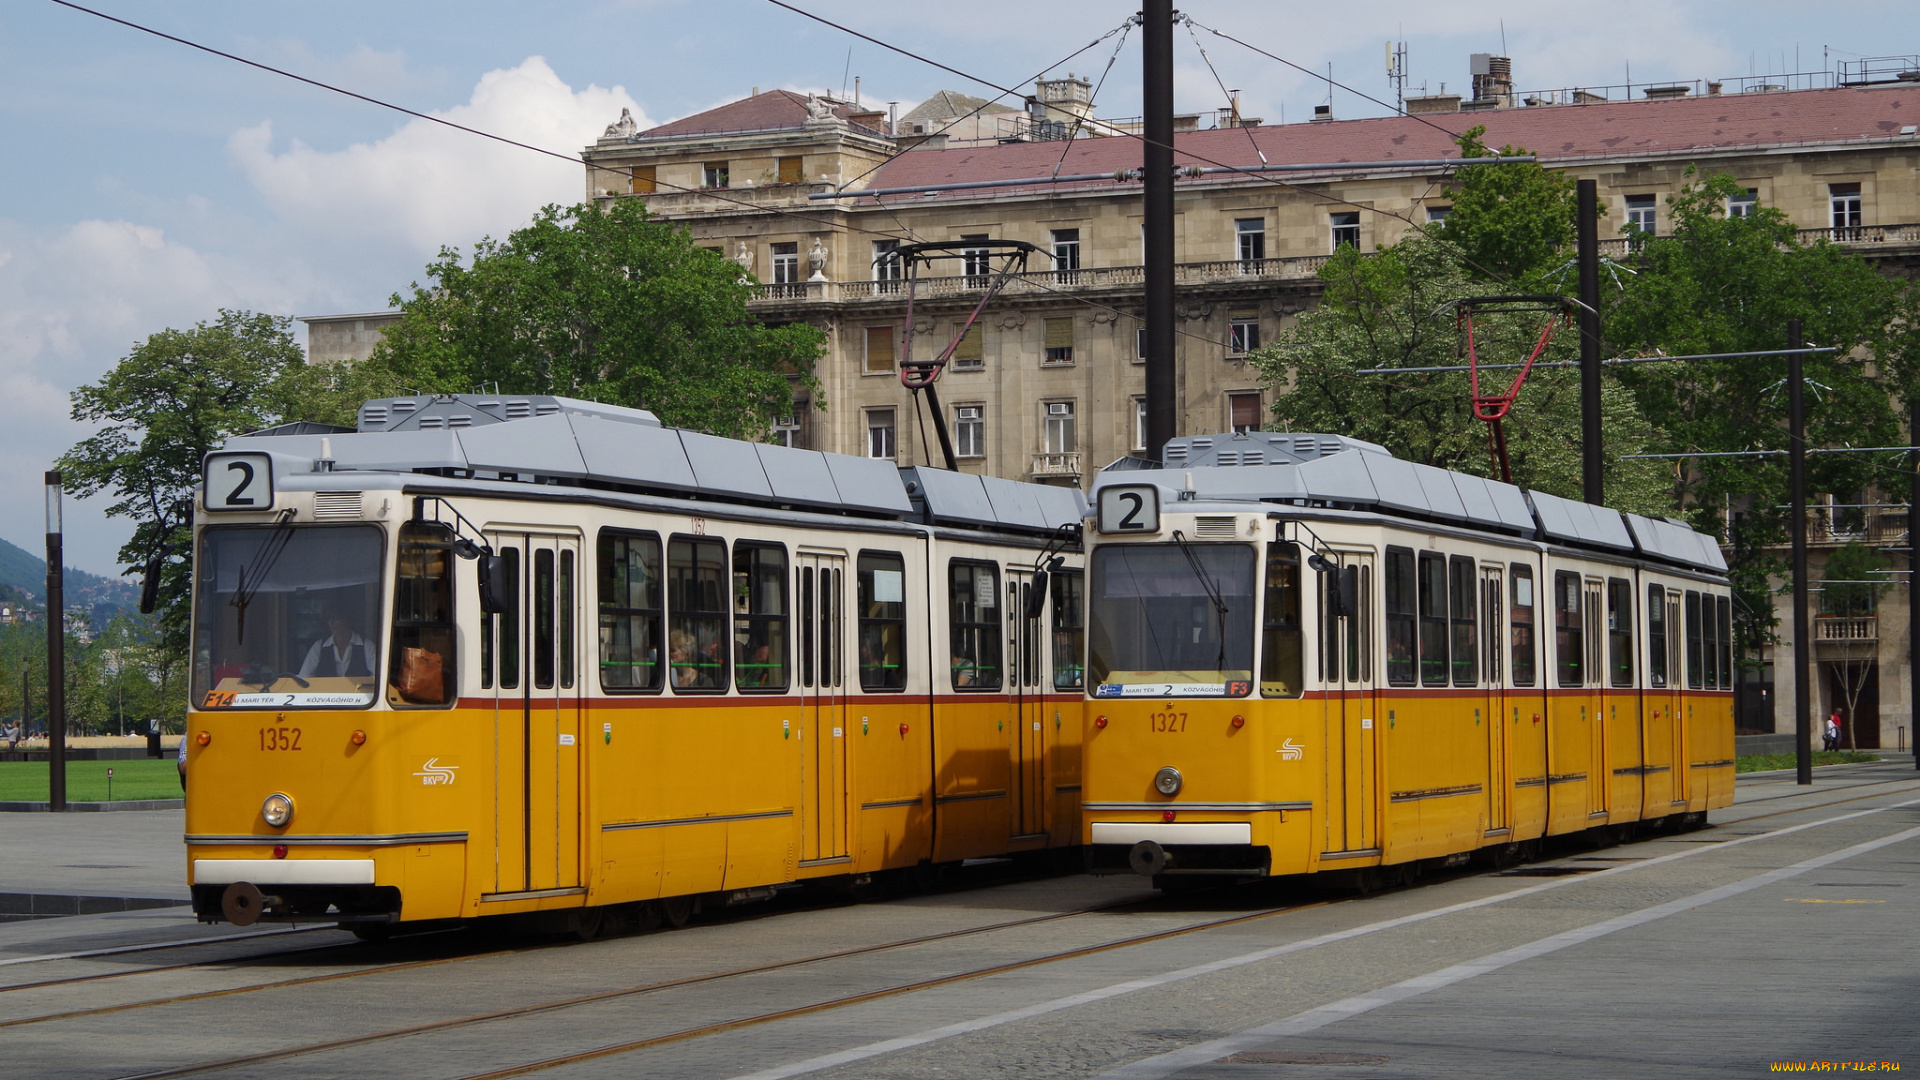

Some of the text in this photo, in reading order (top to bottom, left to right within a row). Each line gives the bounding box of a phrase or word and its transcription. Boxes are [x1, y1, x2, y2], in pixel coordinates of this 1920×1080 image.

[226, 461, 254, 505] 2
[1119, 492, 1144, 529] 2
[1163, 685, 1173, 695] 2
[1230, 682, 1248, 695] F3
[203, 693, 235, 707] F14
[282, 694, 295, 705] 2
[1150, 713, 1188, 733] 1327
[259, 728, 302, 751] 1352
